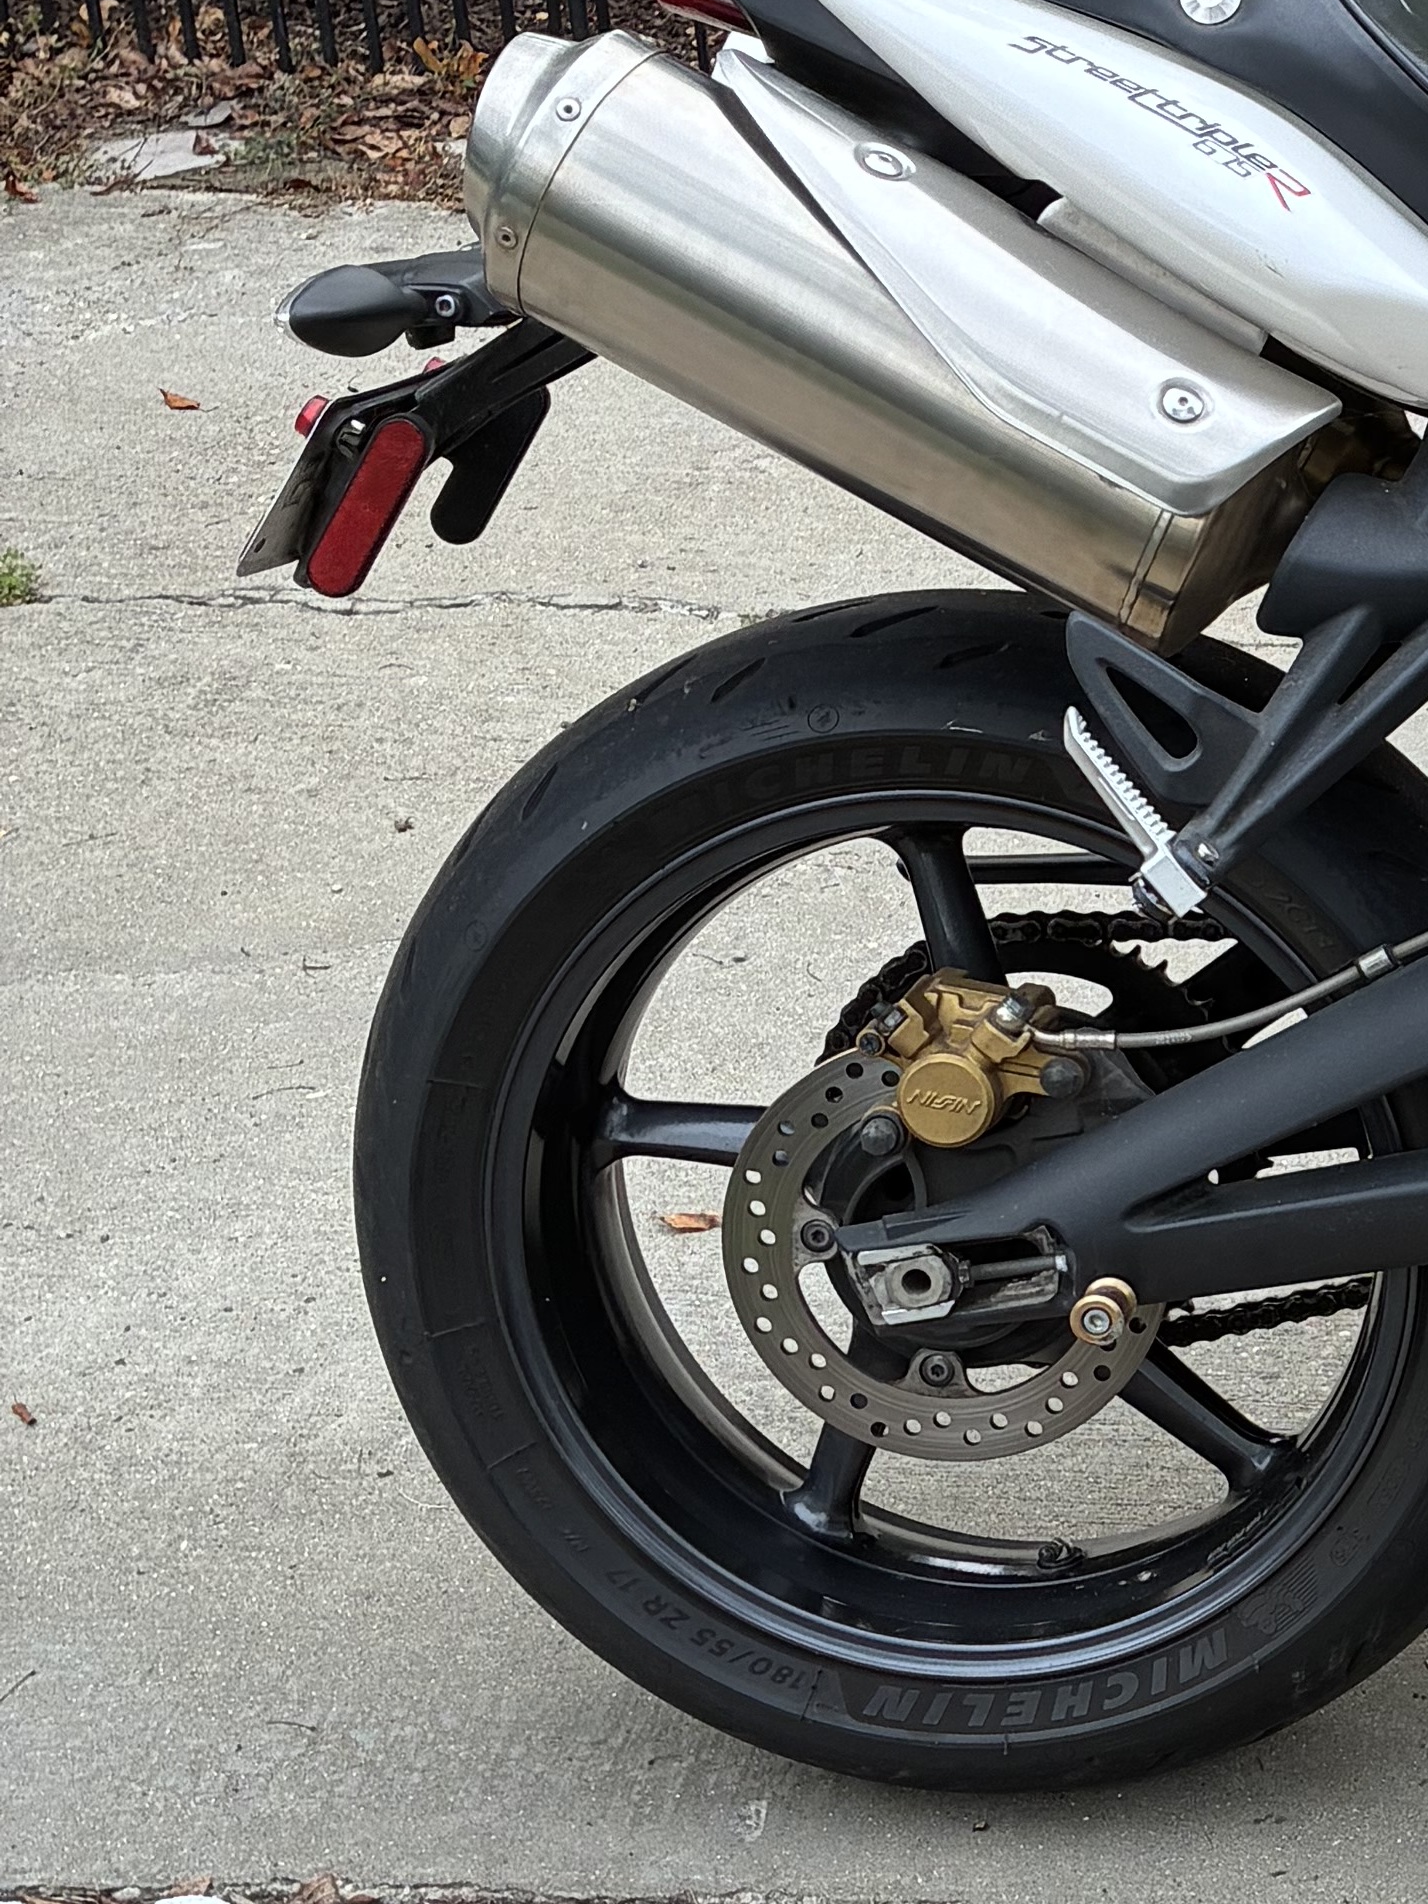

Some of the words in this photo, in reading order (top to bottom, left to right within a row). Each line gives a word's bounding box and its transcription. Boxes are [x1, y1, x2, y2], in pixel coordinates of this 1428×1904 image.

[604, 1567, 645, 1594] 17
[642, 1595, 692, 1631] ZR
[689, 1625, 804, 1692] 180/55
[862, 1627, 1230, 1729] MICHELIN
